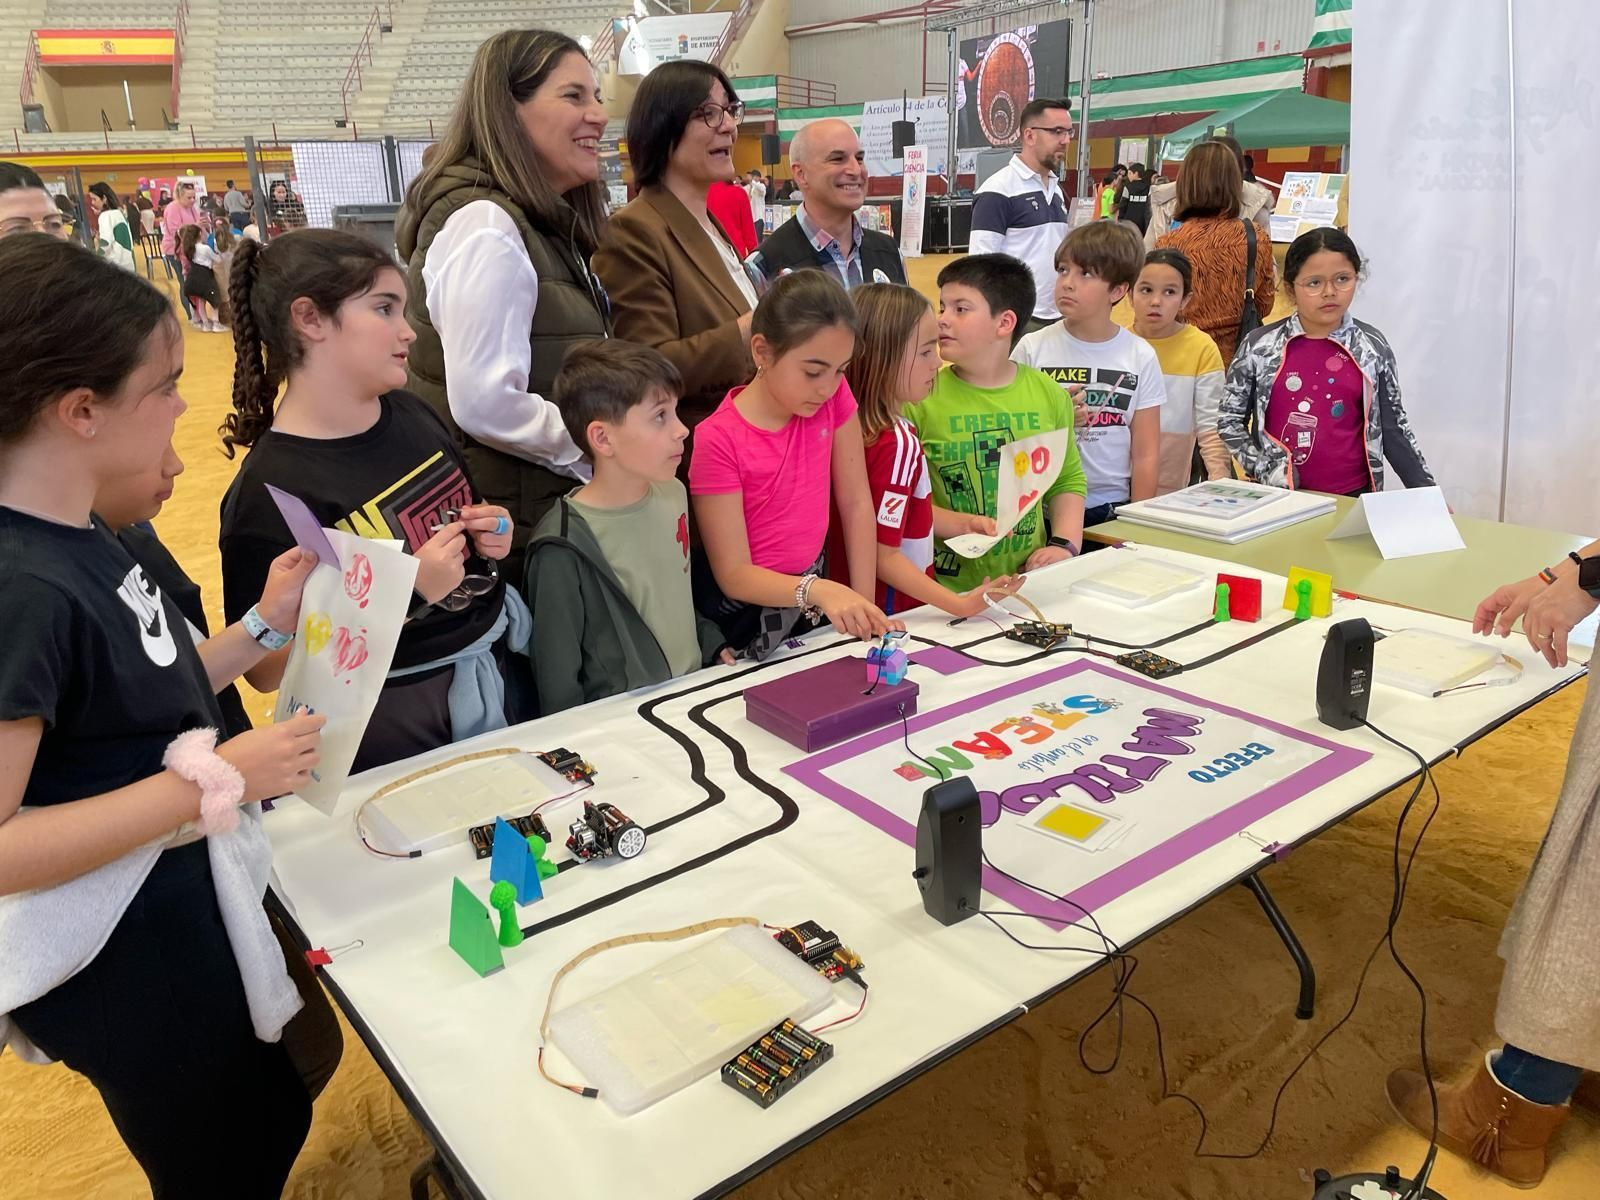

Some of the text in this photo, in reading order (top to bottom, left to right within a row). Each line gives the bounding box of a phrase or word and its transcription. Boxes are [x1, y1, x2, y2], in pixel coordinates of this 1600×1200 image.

[866, 103, 901, 115] Artículo
[914, 100, 925, 110] de
[927, 99, 935, 109] la
[908, 150, 922, 160] FERIA
[903, 163, 925, 174] CIENCIA
[1043, 368, 1088, 382] MAKE
[949, 411, 1041, 434] CREATE
[880, 514, 899, 524] LALIGA
[116, 563, 161, 630] NIKE
[900, 694, 1115, 780] STEAM
[1187, 742, 1276, 784] EFECTO
